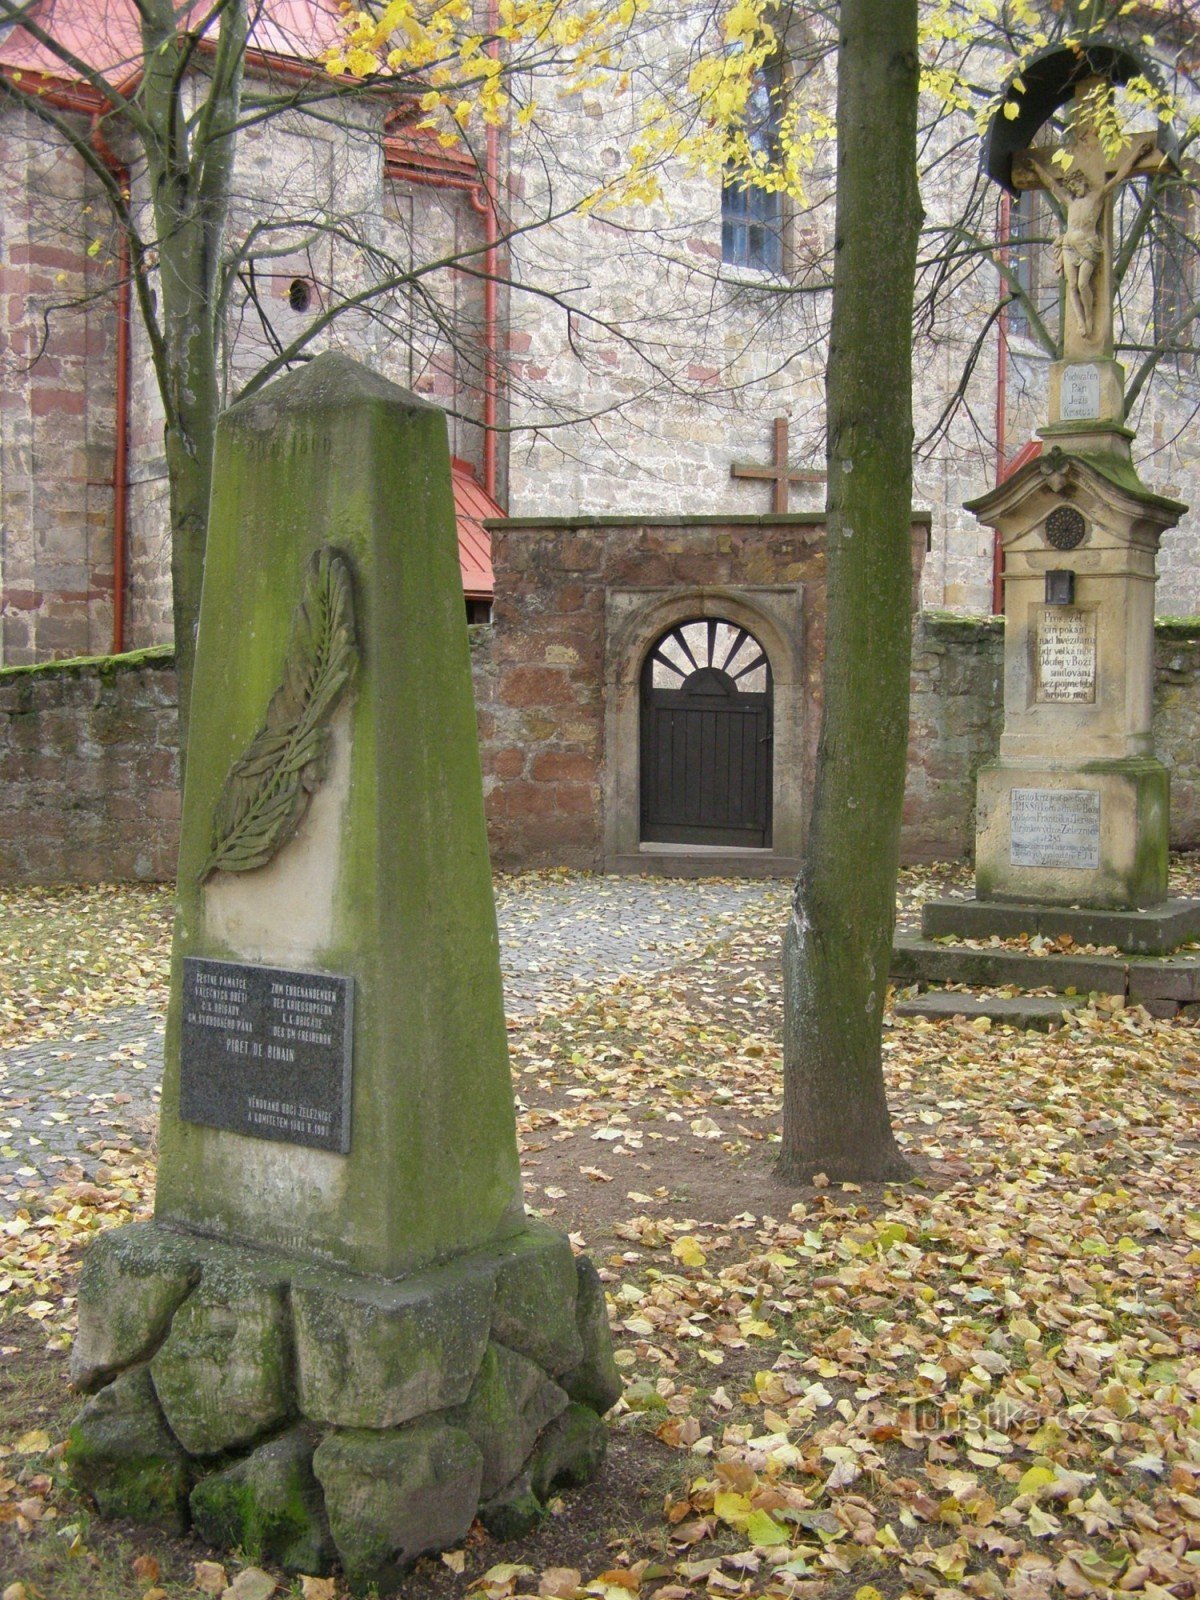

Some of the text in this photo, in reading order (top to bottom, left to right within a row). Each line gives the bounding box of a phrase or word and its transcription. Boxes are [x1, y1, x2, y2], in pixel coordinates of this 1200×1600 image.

[271, 983, 337, 1003] ZUM EHRENANDENKEN
[273, 997, 333, 1016] DES KRIEGSOPFERN
[273, 1026, 332, 1046] DES GM FREIHERRN
[226, 1038, 296, 1063] PIRET DE BIHAIN
[297, 1104, 333, 1124] ŽELEZNICE
